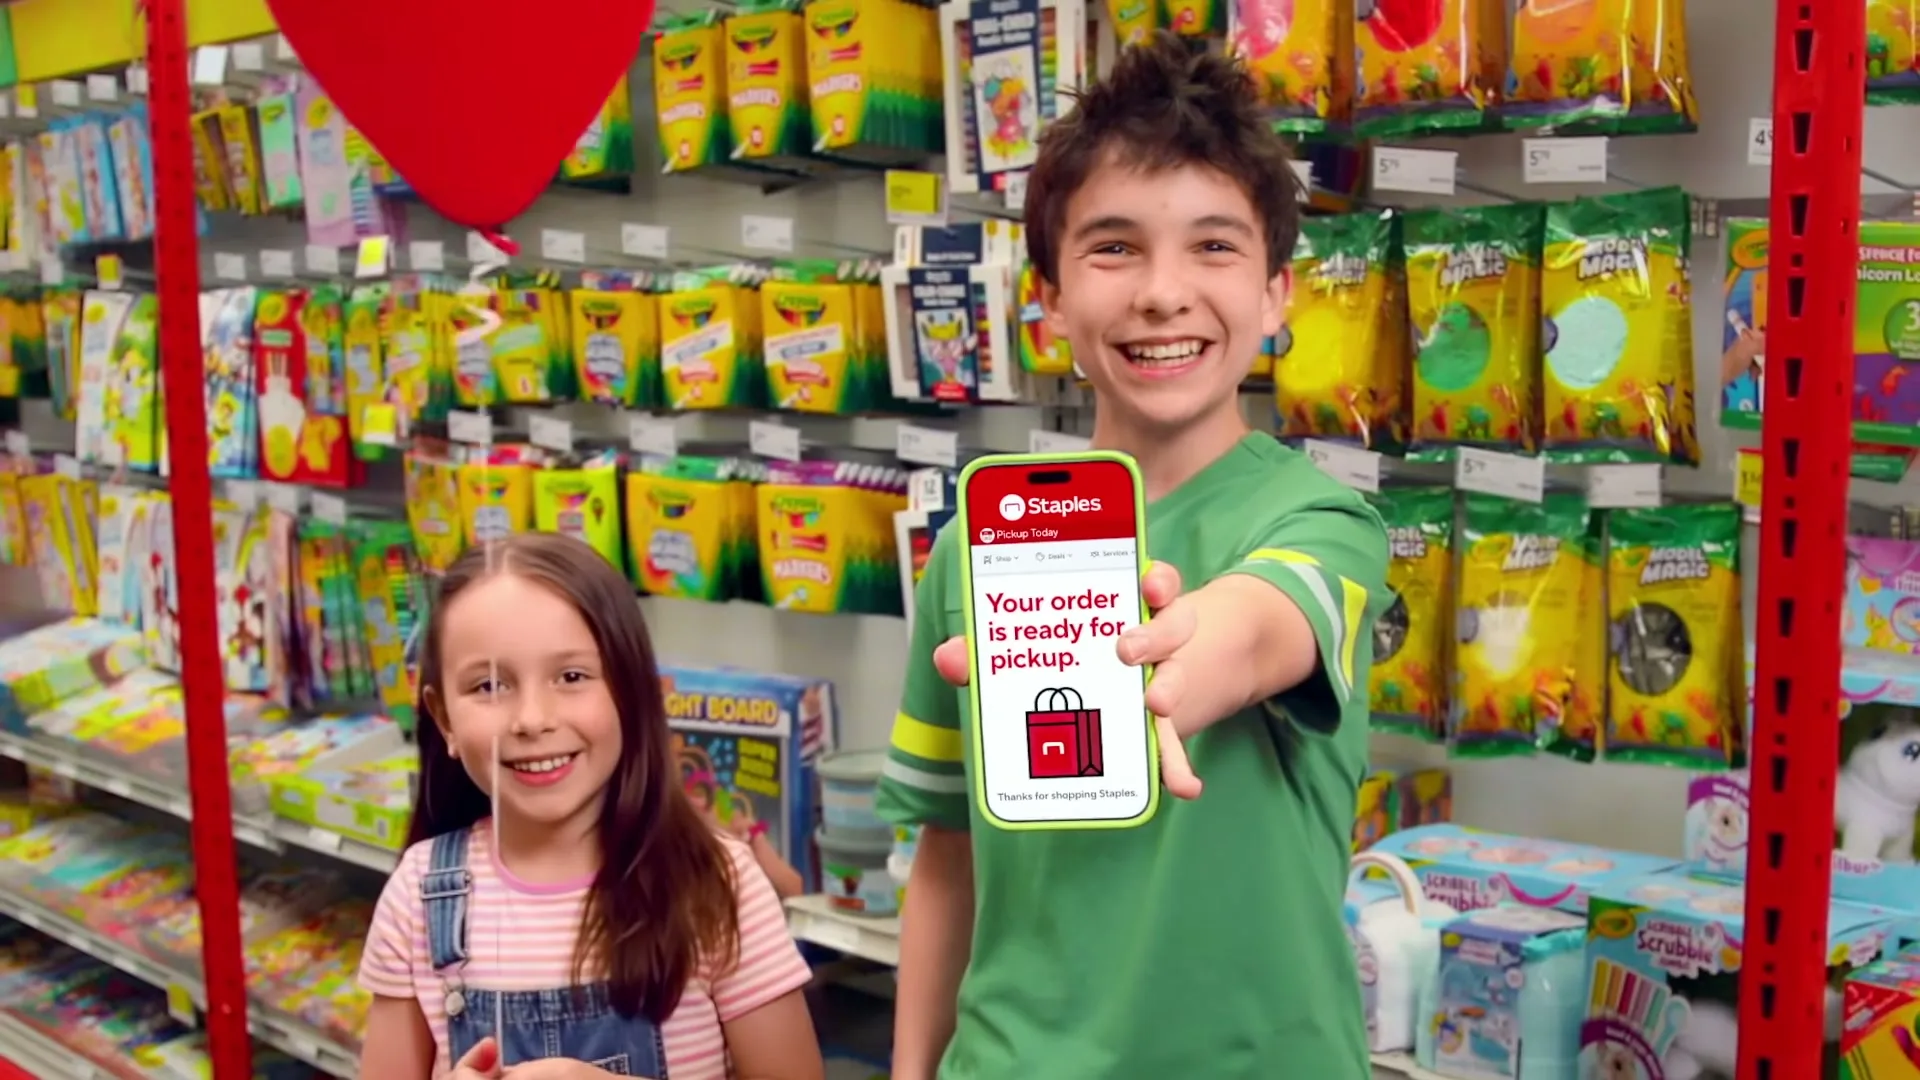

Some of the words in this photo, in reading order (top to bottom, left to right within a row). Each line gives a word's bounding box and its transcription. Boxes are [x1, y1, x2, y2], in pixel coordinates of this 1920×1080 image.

[1028, 495, 1102, 517] Staples
[996, 530, 1029, 540] Pickup
[1031, 528, 1059, 538] Today
[996, 555, 1012, 563] Shop
[1048, 552, 1065, 560] Deals
[986, 592, 1044, 613] Your
[1051, 589, 1119, 610] order
[988, 621, 1007, 641] is
[1014, 618, 1083, 644] ready
[1090, 616, 1125, 637] for
[991, 648, 1080, 675] pickup.
[998, 792, 1033, 802] Thanks
[1035, 791, 1049, 801] for
[1051, 790, 1097, 803] shopping
[1099, 789, 1138, 800] Staples.
